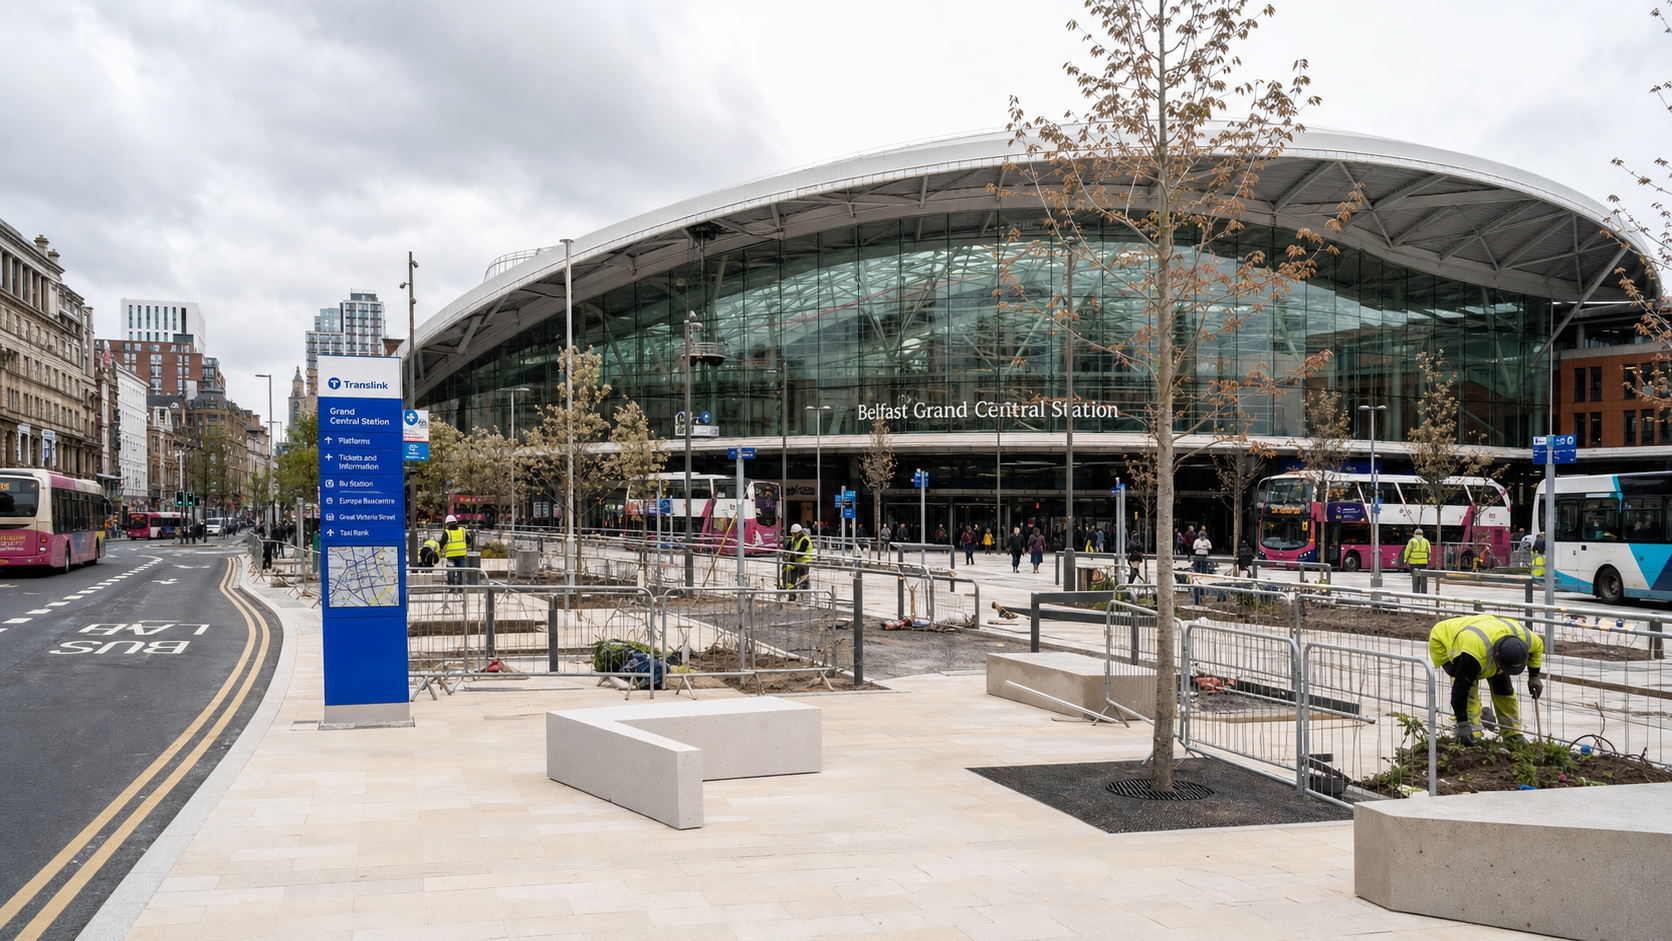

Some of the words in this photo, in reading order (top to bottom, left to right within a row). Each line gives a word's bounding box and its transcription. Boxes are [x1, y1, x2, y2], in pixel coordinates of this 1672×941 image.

[344, 380, 388, 390] Translink
[330, 407, 355, 416] Grand
[858, 402, 908, 420] Belfast
[914, 401, 968, 418] Grand
[975, 400, 1046, 418] Central
[1051, 400, 1119, 418] Station
[330, 417, 359, 425] Central
[361, 417, 389, 425] Station
[338, 437, 370, 445] Platforms
[49, 640, 190, 655] BUS
